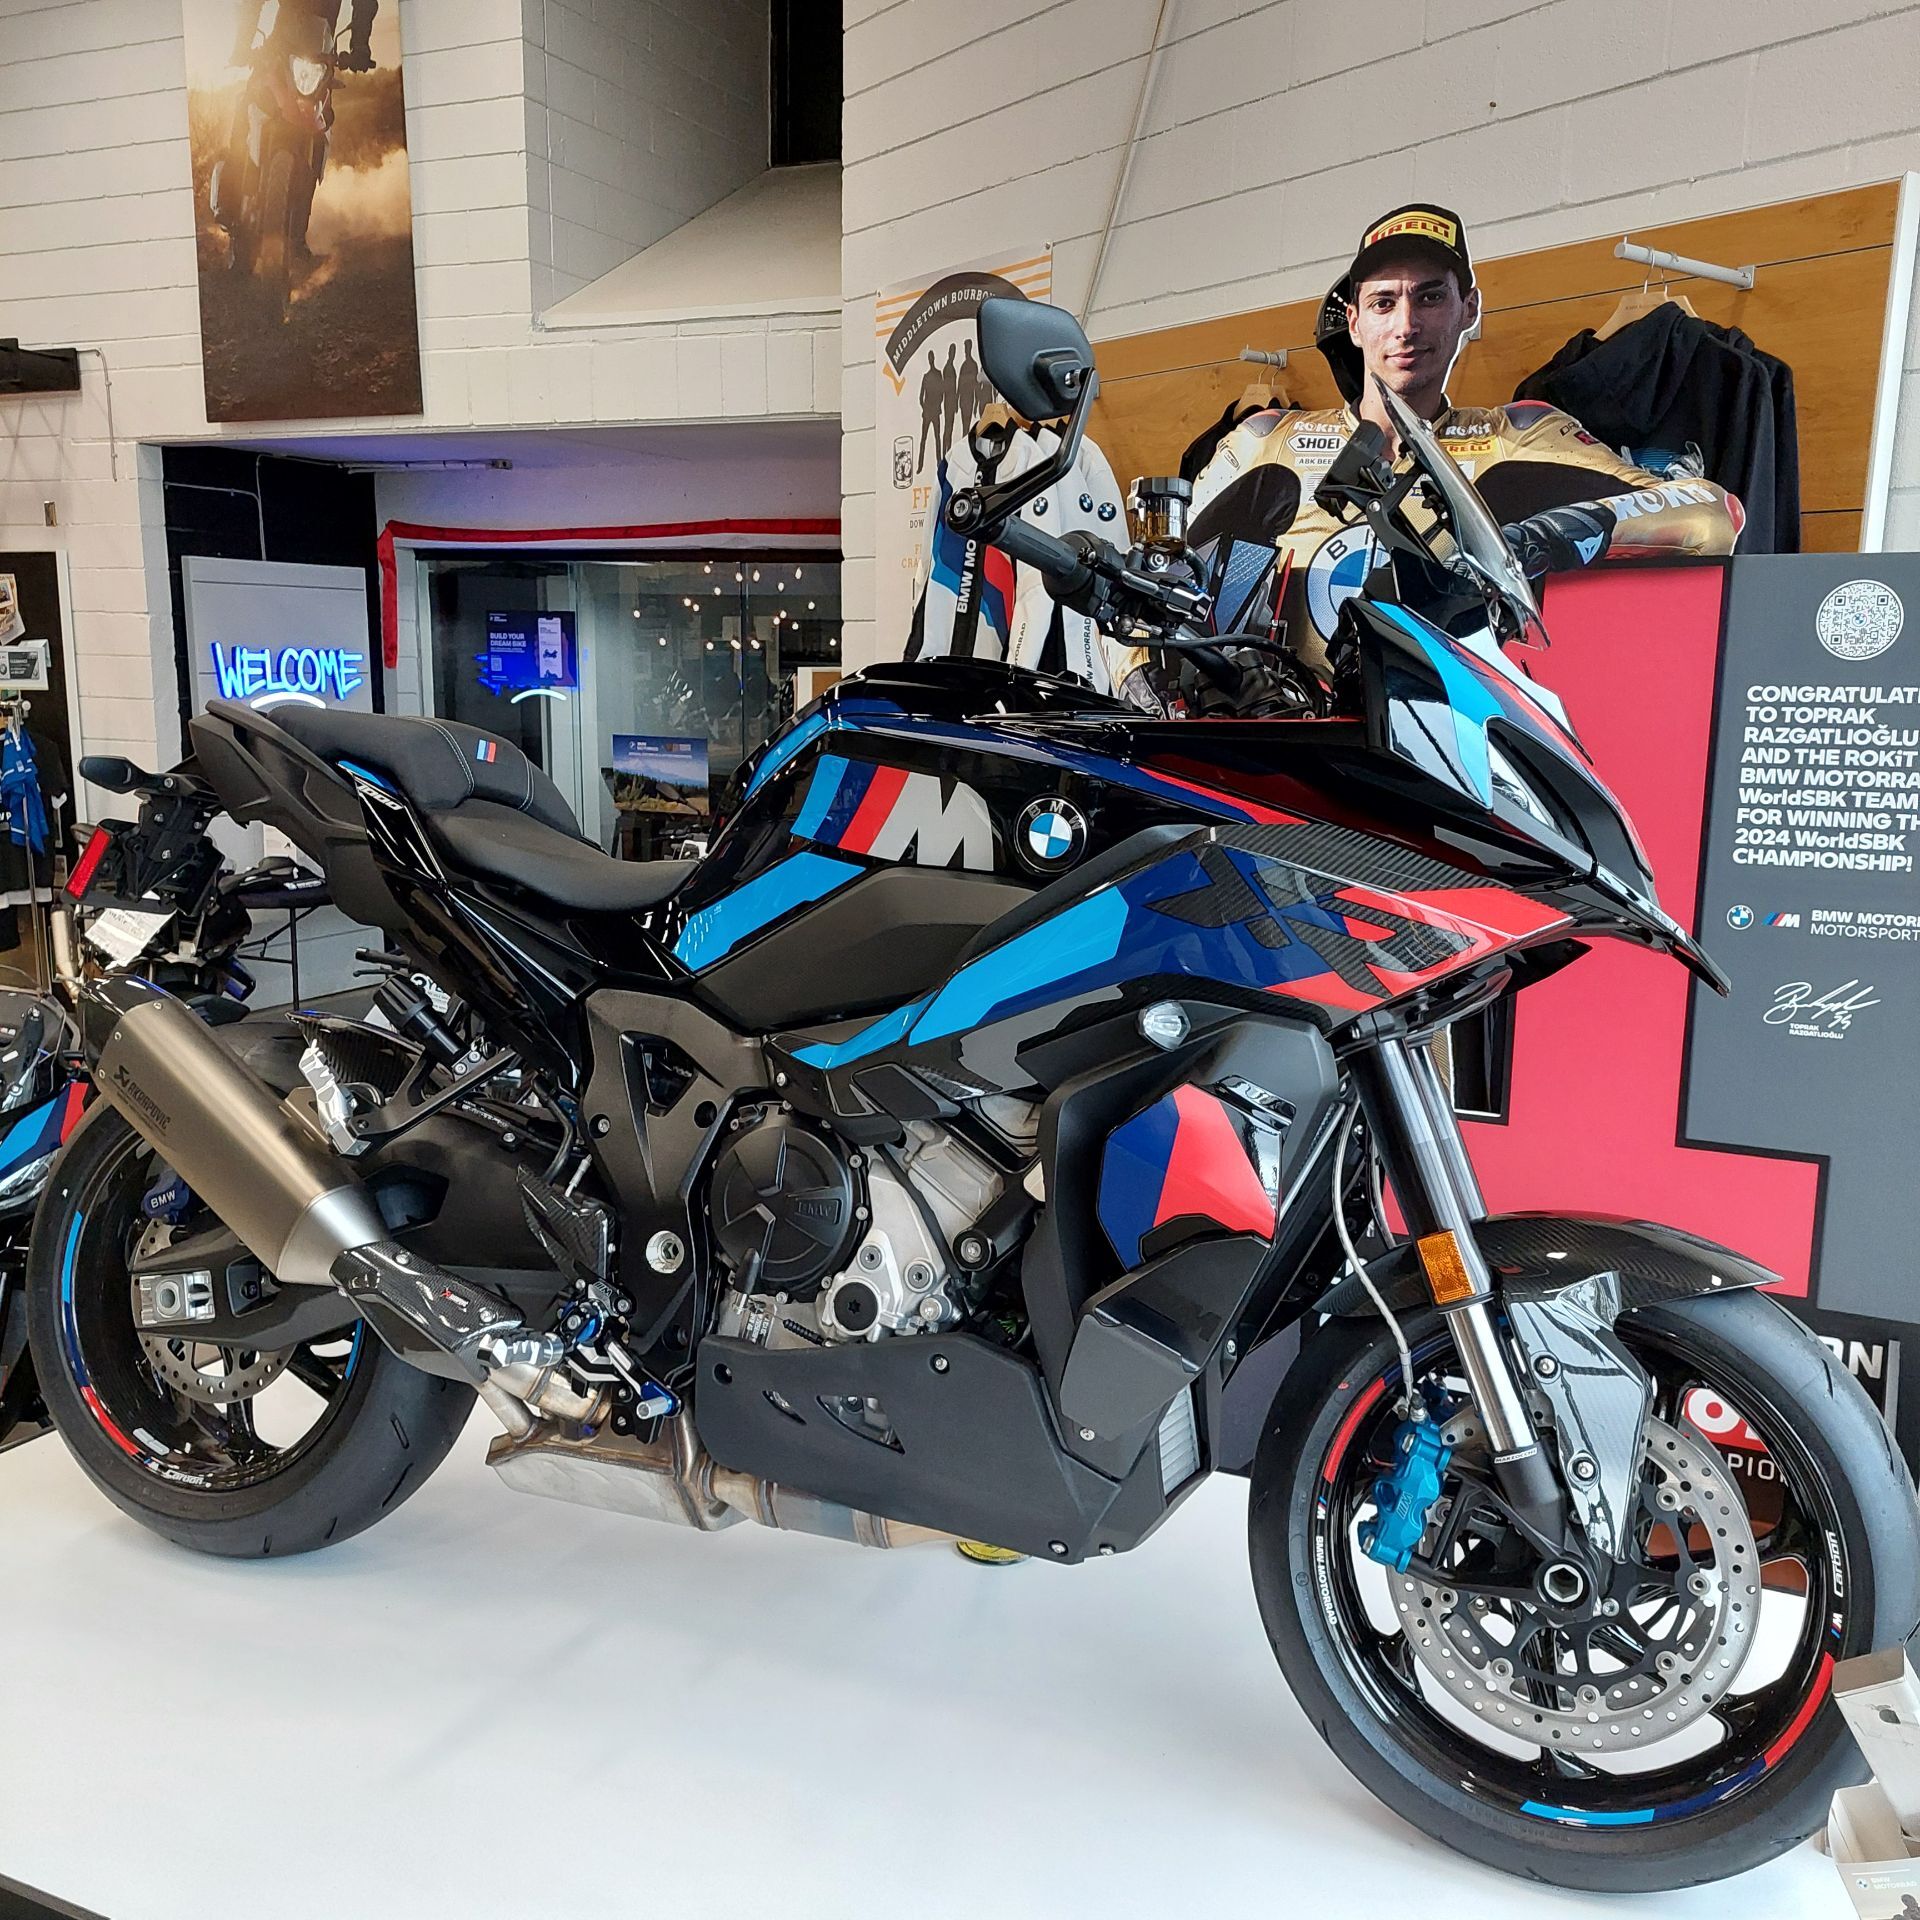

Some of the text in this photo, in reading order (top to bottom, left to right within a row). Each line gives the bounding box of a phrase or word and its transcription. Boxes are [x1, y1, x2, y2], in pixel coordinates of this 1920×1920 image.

[893, 288, 995, 364] MIDDLETOWN BOURBO
[1297, 438, 1339, 449] SHOEI
[957, 572, 973, 614] BMW
[1083, 617, 1094, 668] MOTORRAD
[211, 641, 363, 700] WELCOME
[1746, 706, 1877, 725] TO TOPRAK
[1743, 724, 1919, 746] RAZGATLIOĞLU
[1741, 747, 1918, 767] AND THE ROKiT
[1740, 768, 1800, 785] BMW
[1739, 788, 1919, 809] WorldSBK TEAM
[1027, 801, 1084, 830] BMW
[1736, 808, 1782, 825] FOR
[1787, 810, 1892, 829] WINNING
[1735, 828, 1906, 851] 2024 WorldSBK
[1732, 848, 1913, 872] CHAMPIONSHIP!
[1811, 910, 1853, 923] BMW
[1810, 925, 1920, 941] MOTORSPORT
[1789, 1022, 1819, 1031] TOPRAK
[150, 1189, 176, 1209] BMW
[1315, 1535, 1325, 1562] BMW
[1317, 1565, 1338, 1625] MOTORRAD
